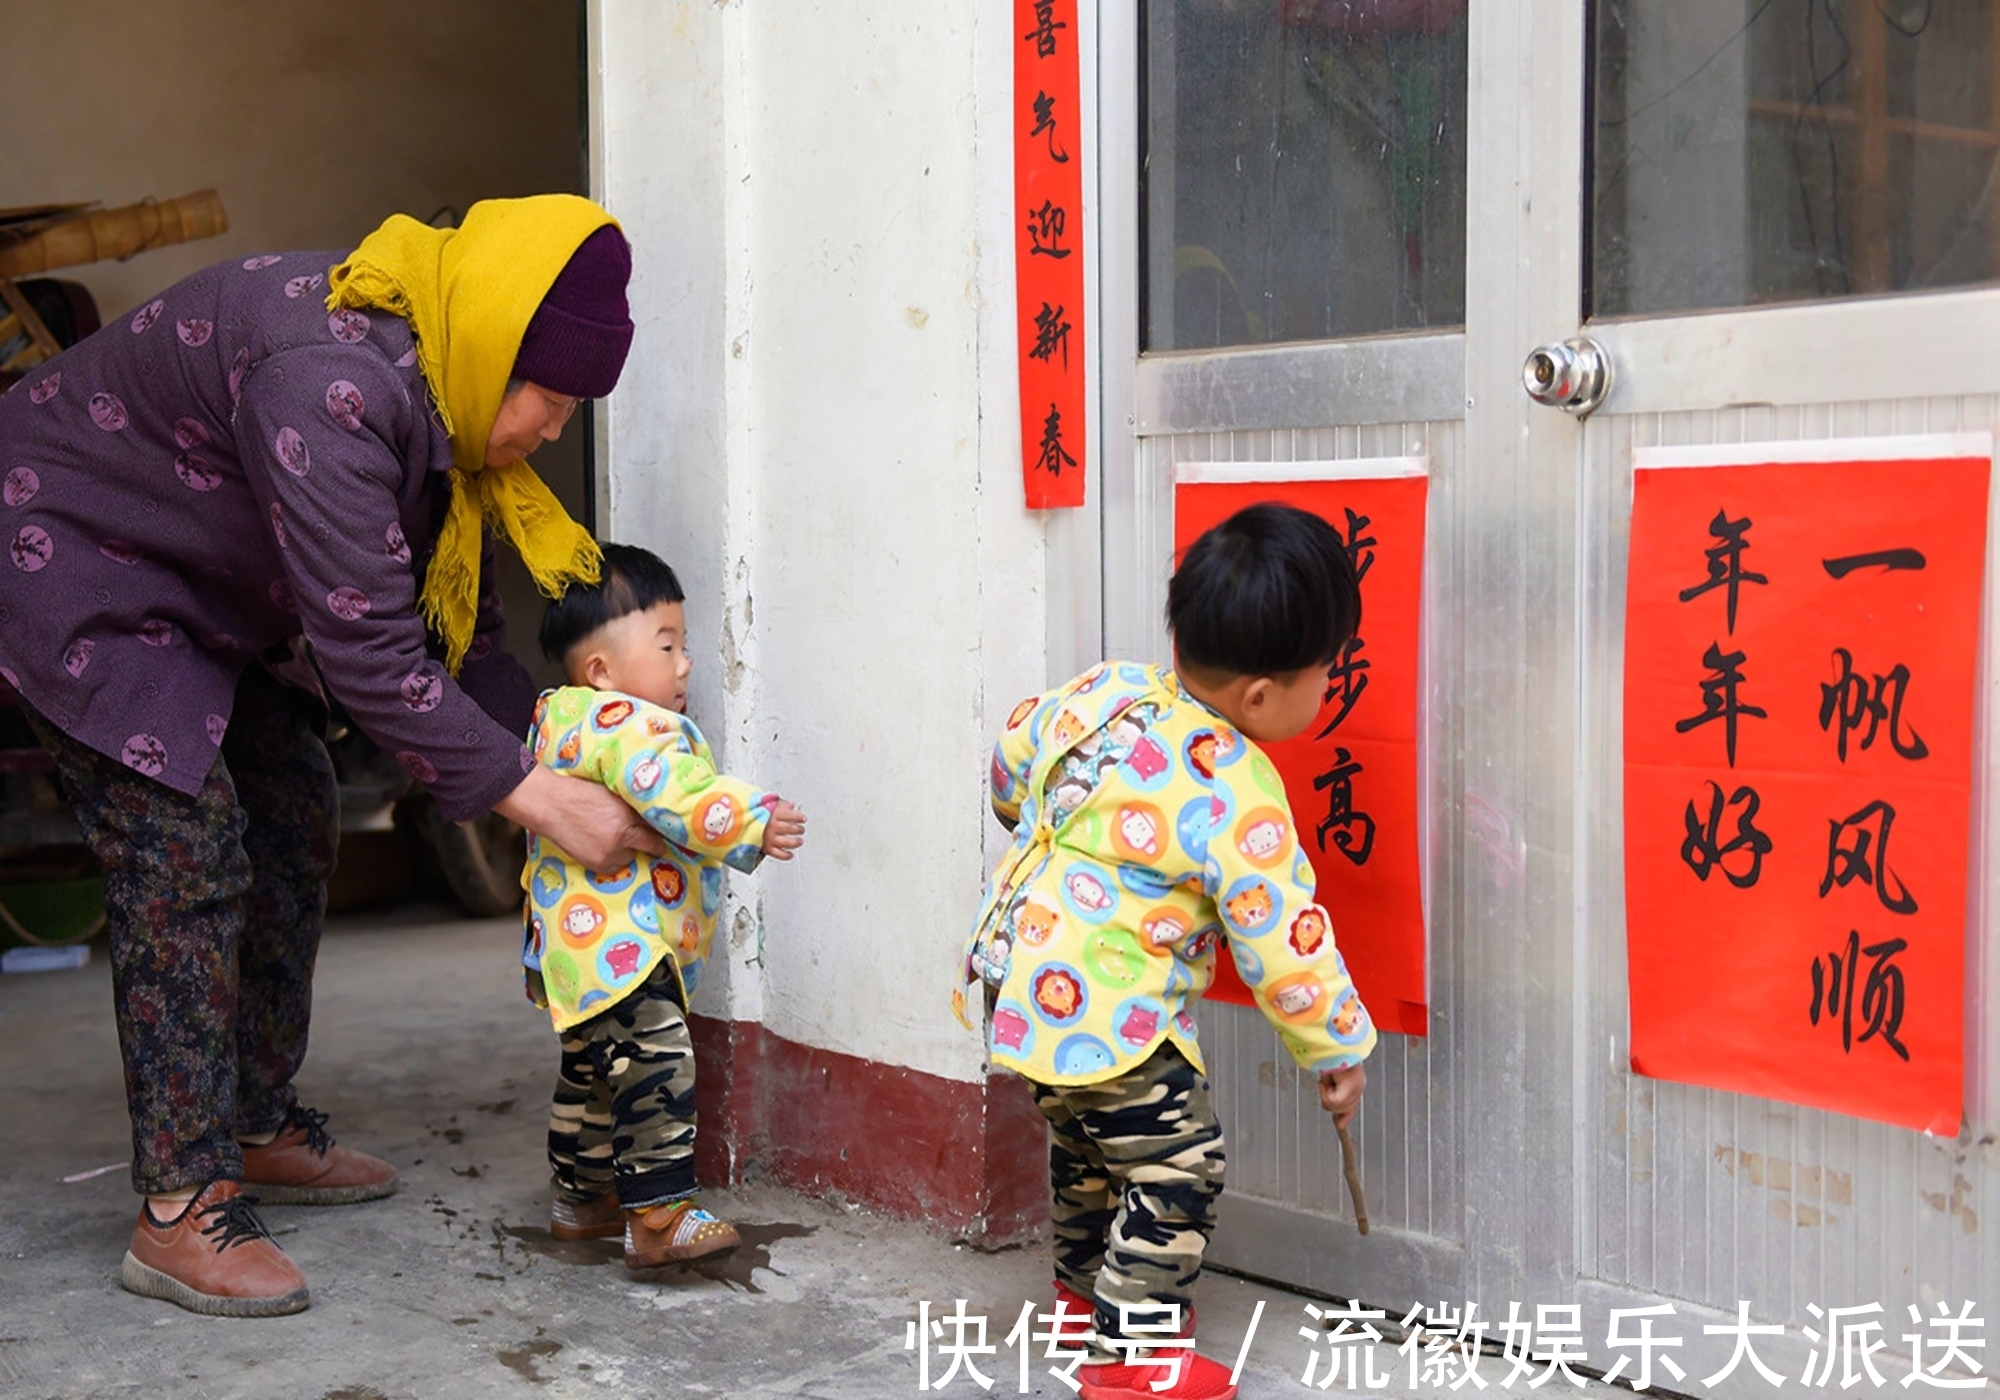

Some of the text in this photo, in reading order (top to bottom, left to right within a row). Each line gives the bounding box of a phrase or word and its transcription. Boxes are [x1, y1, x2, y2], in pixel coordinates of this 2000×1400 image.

[1024, 0, 1077, 476] 喜气迎新春
[1675, 508, 1773, 889] 年年好
[1809, 547, 1929, 1062] 一帆风顺
